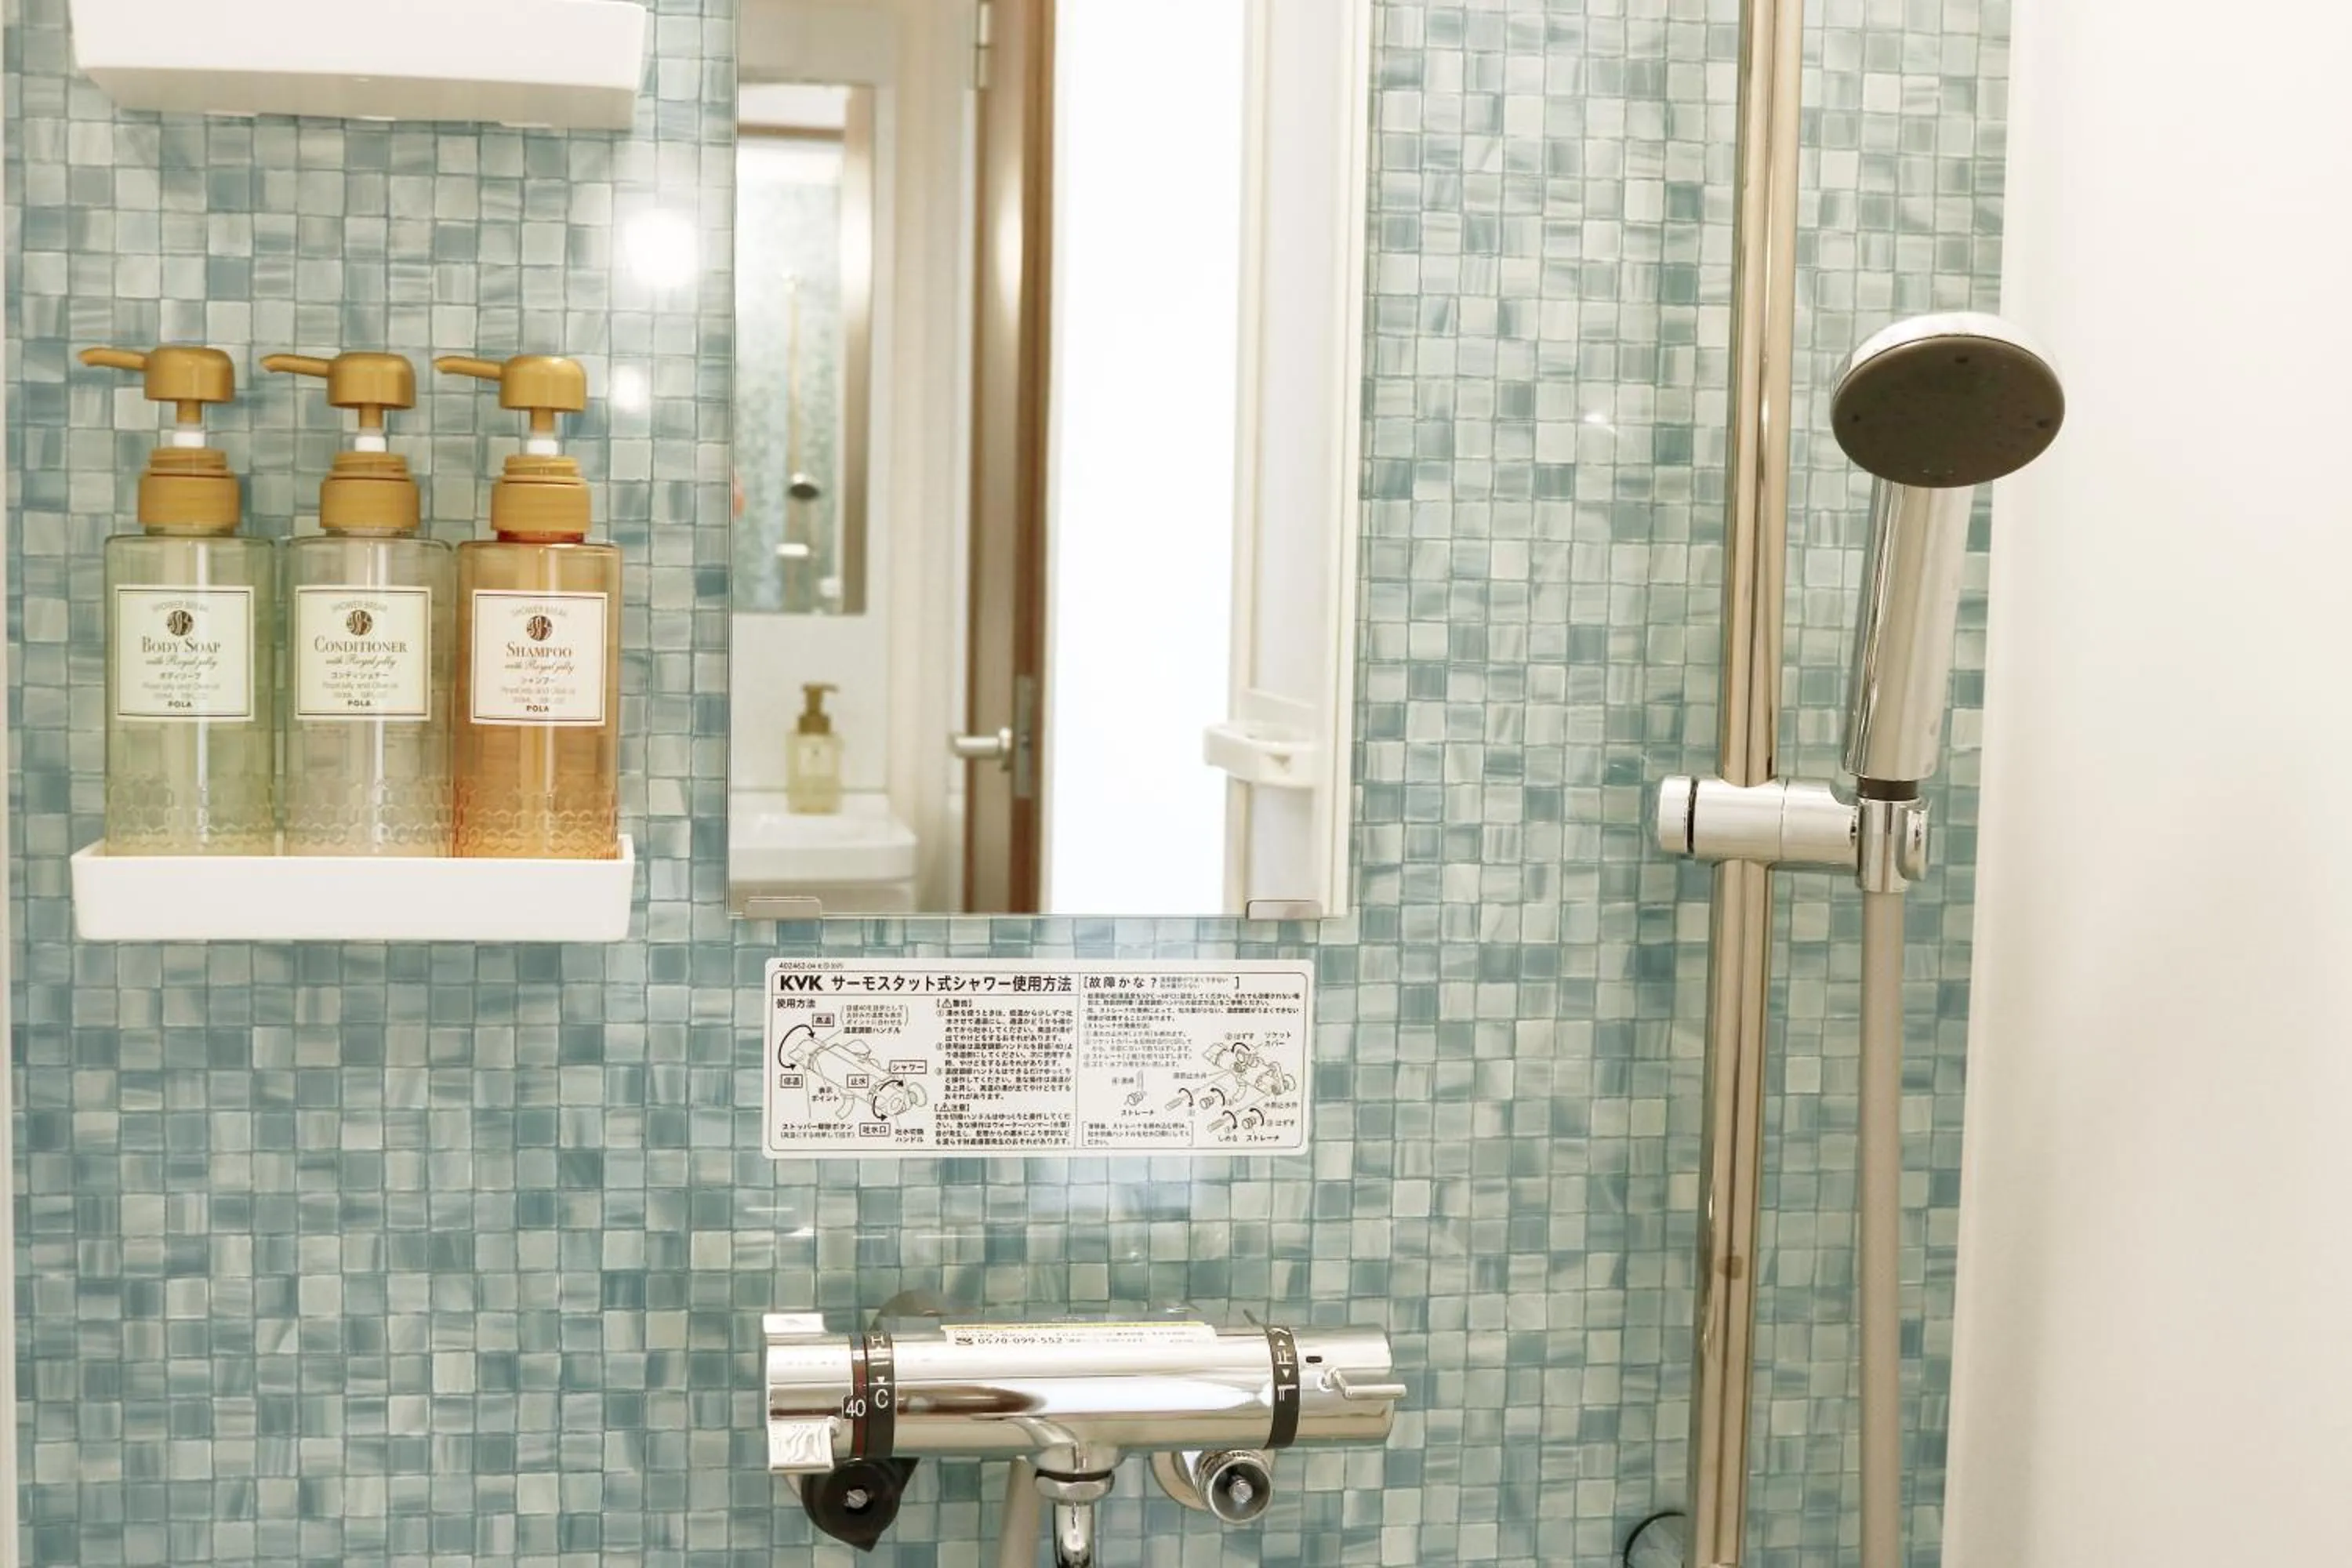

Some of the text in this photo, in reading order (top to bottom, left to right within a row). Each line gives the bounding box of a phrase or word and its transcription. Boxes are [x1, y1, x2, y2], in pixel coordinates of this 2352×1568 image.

[526, 704, 550, 713] POLA
[780, 975, 1073, 993] KVK サーモスタット式シャワー使用方法
[893, 1063, 925, 1072] シャワー
[875, 1388, 889, 1409] C
[845, 1399, 866, 1417] 40
